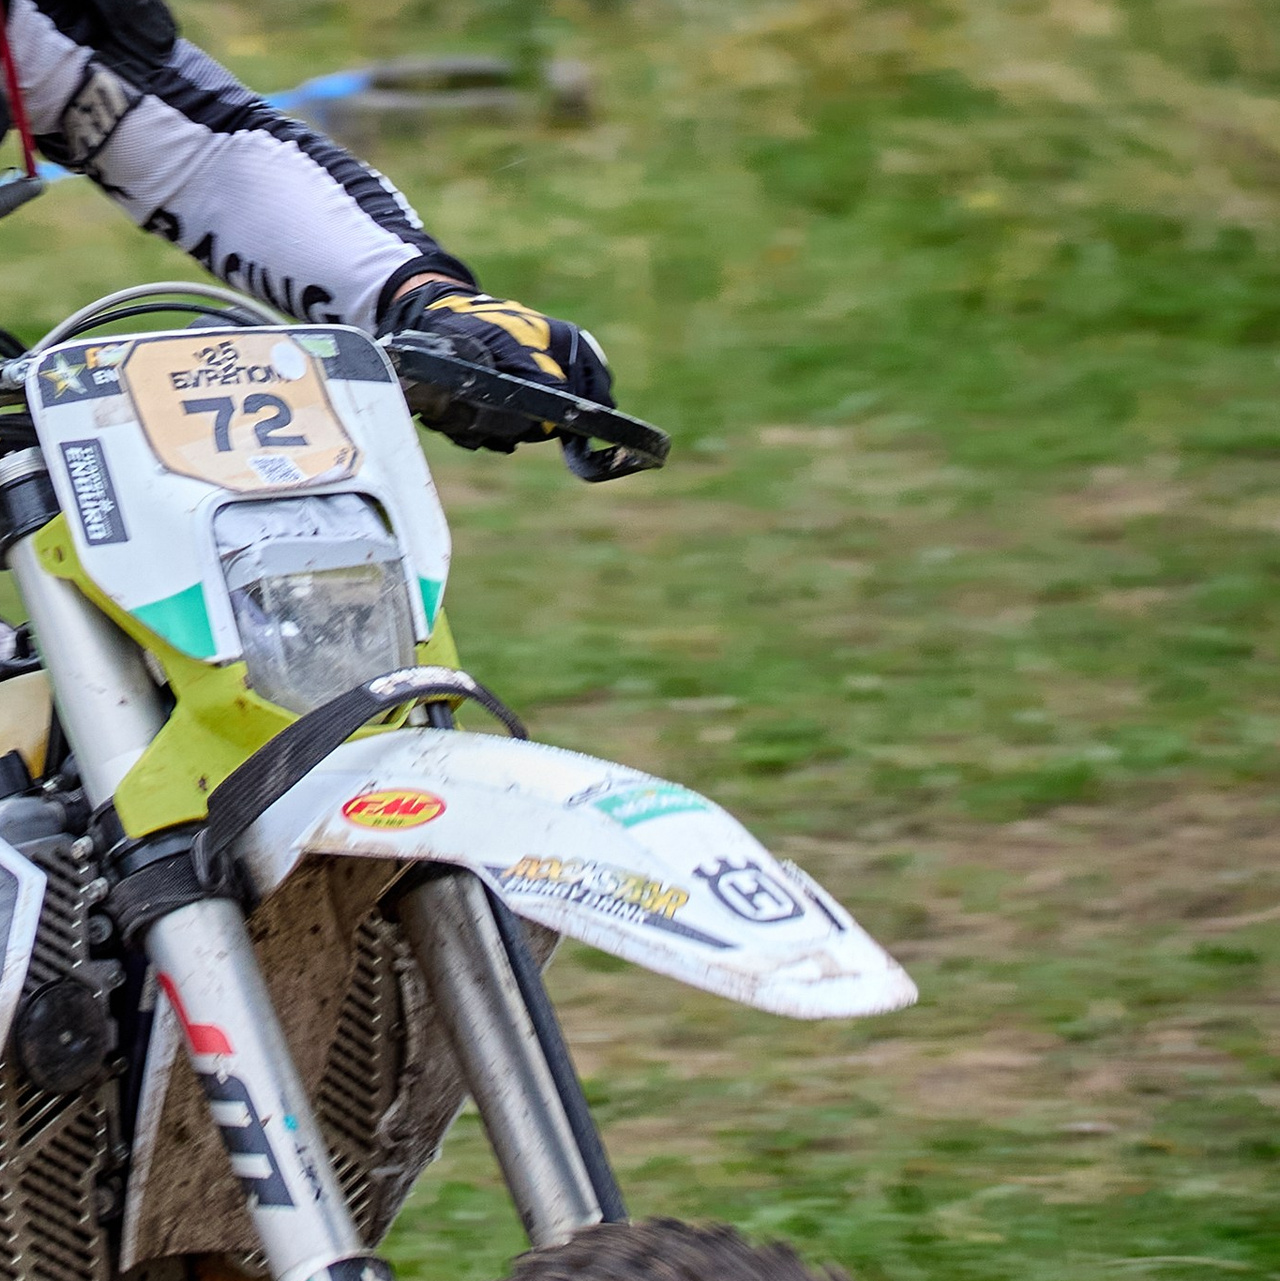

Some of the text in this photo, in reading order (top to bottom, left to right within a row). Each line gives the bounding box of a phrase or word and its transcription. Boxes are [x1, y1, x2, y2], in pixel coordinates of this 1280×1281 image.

[180, 392, 310, 452] 72
[345, 797, 441, 817] FMF
[501, 854, 690, 920] ROCKSTAR
[581, 888, 646, 925] DRINK
